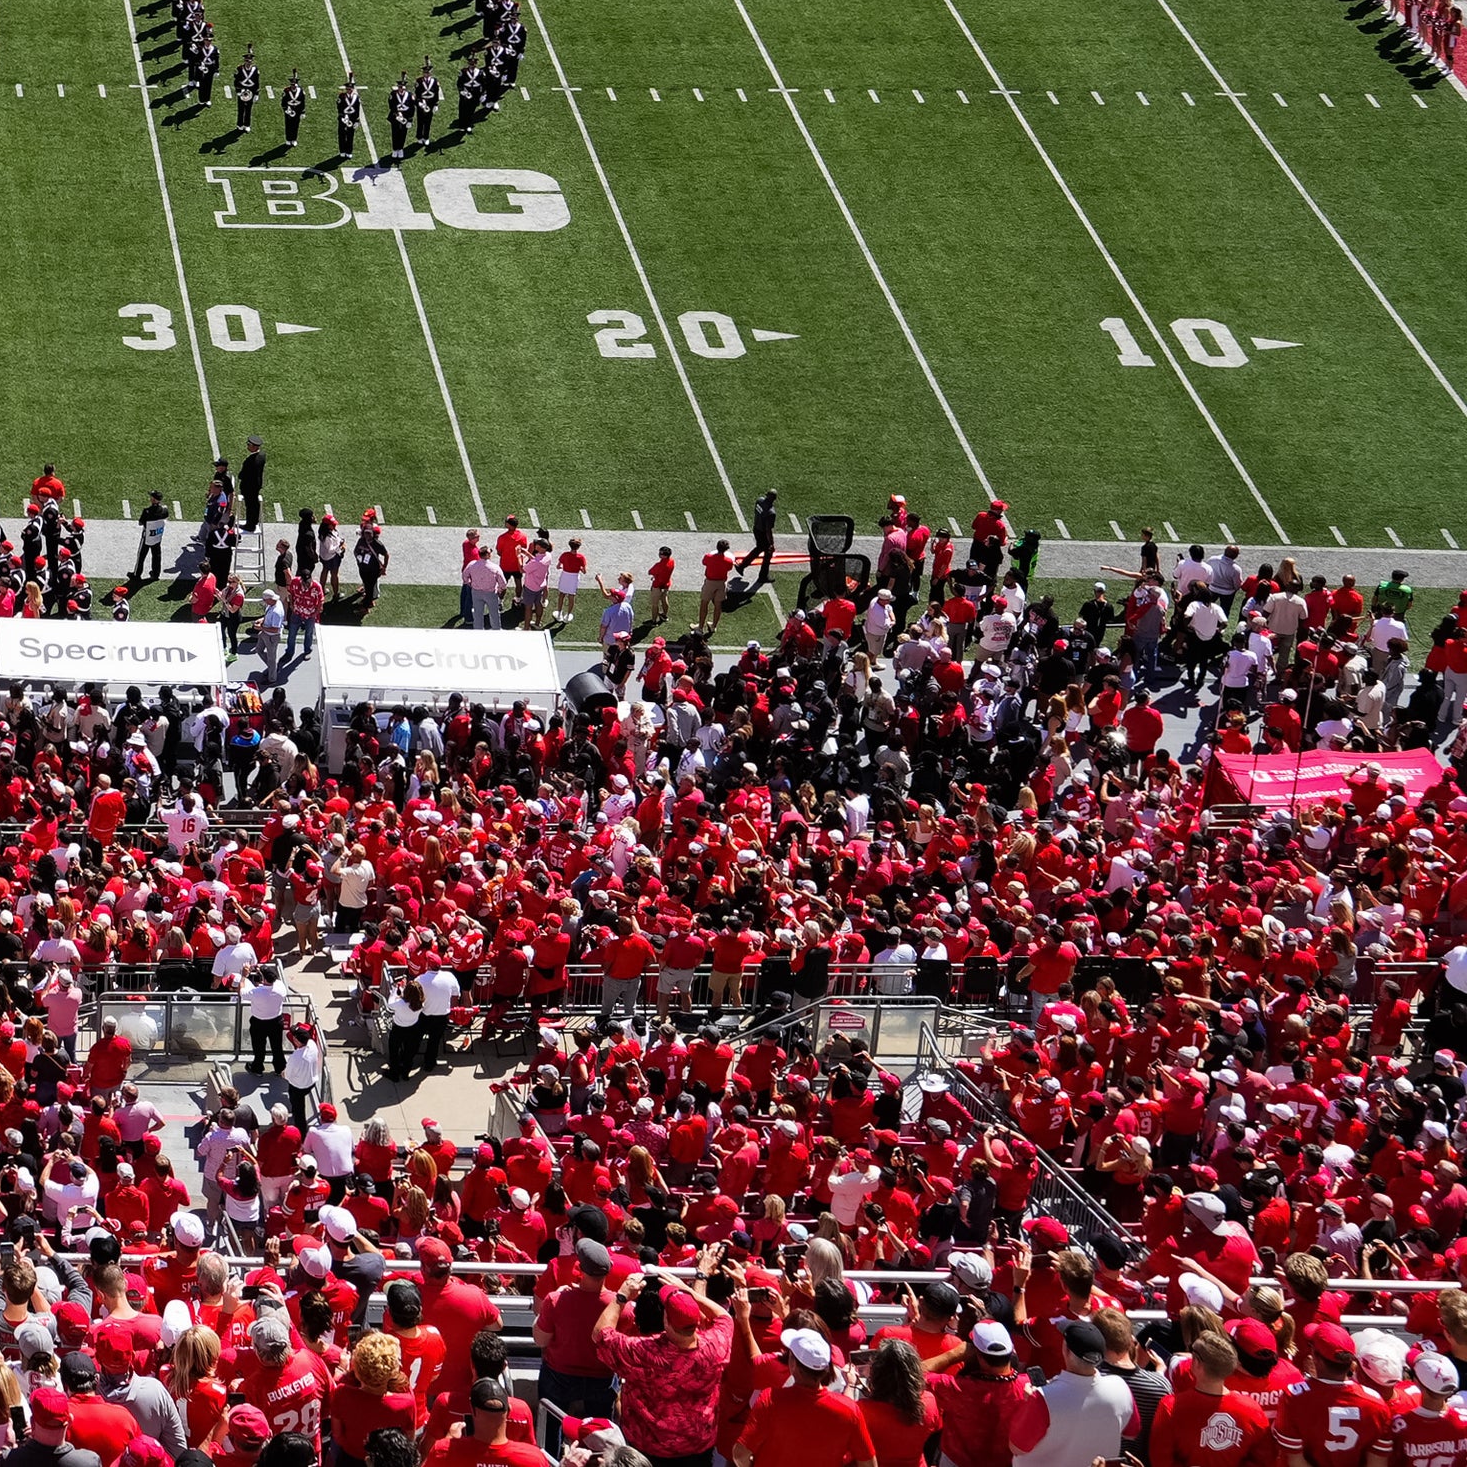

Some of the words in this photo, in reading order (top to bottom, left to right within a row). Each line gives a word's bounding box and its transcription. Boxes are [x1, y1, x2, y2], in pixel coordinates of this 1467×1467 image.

[118, 302, 262, 351] 30
[586, 309, 750, 362] 20
[1100, 316, 1253, 370] 10
[18, 637, 187, 664] Spectrum
[345, 644, 518, 671] Spectrum
[182, 818, 196, 833] 16
[1151, 1036, 1161, 1053] 5
[267, 1371, 316, 1403] BUCKEYES
[273, 1398, 321, 1439] 28
[1325, 1406, 1364, 1452] 5
[1200, 1424, 1218, 1448] OHIO
[1217, 1423, 1243, 1449] STATE
